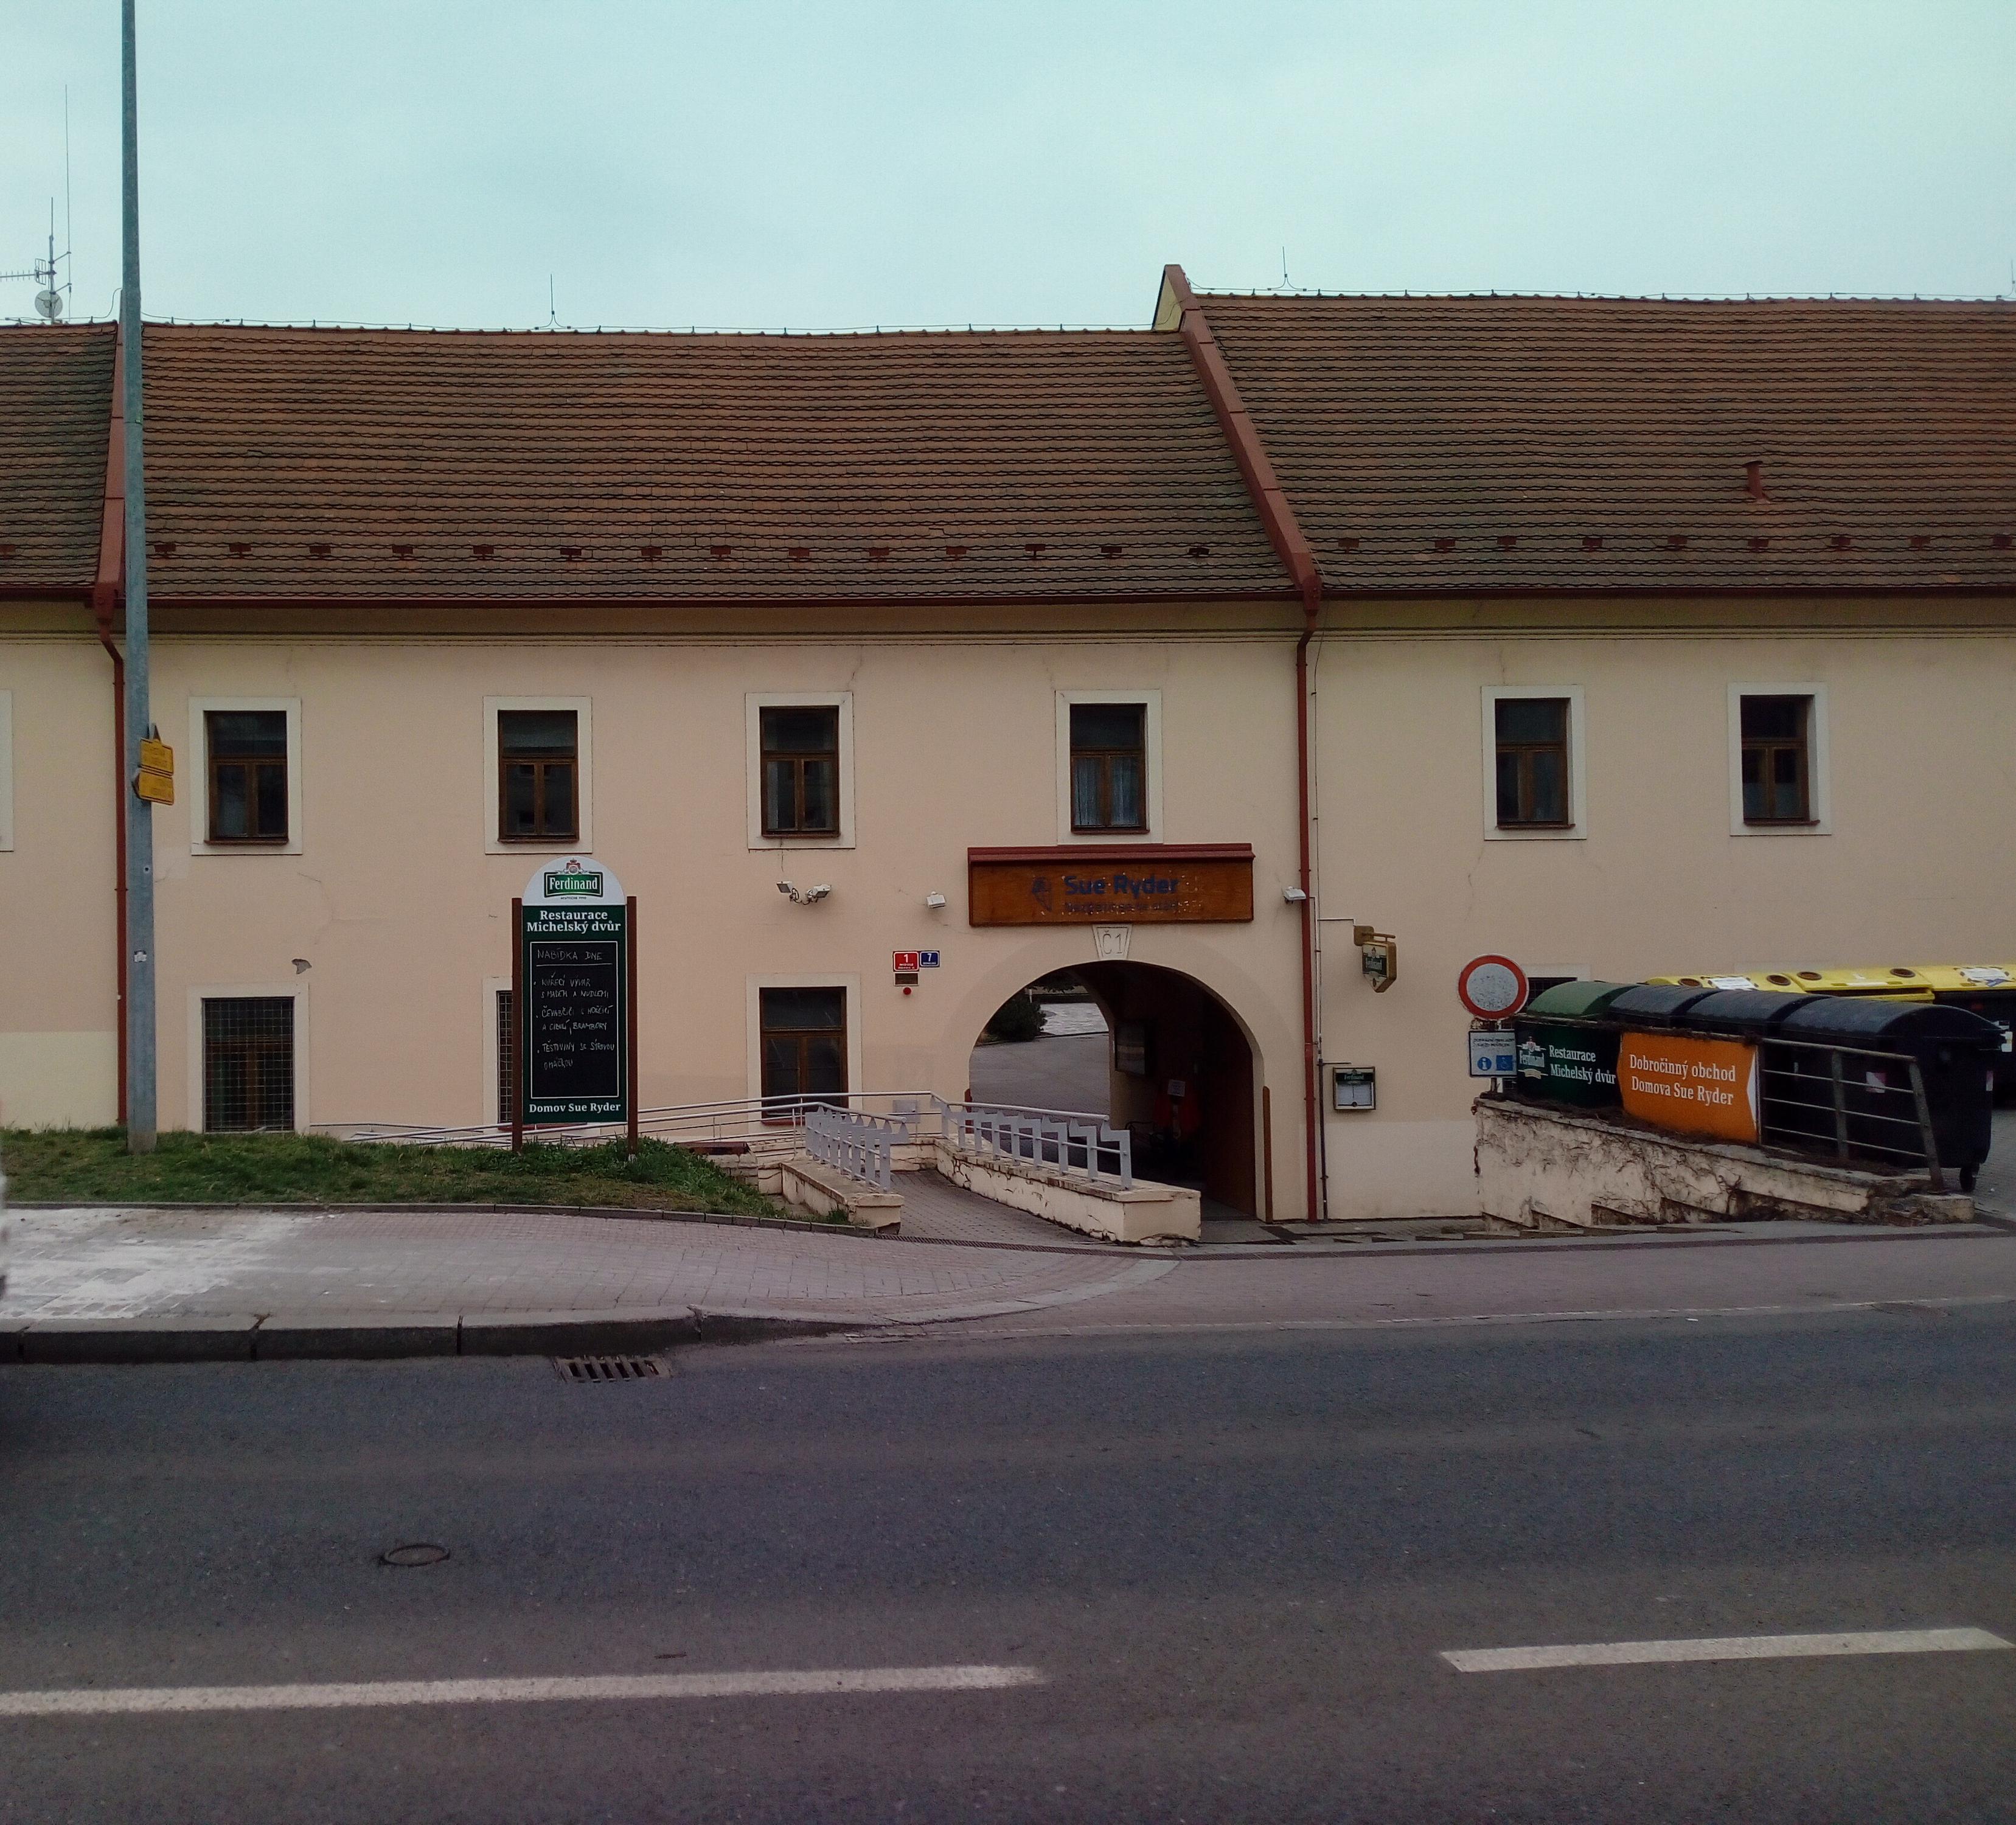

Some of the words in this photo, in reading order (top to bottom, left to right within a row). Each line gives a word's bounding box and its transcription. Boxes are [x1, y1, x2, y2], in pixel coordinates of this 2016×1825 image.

[549, 877, 598, 890] Ferdinand
[1065, 875, 1106, 895] Sue
[1113, 874, 1180, 899] Ryder
[540, 910, 608, 920] Restaurace
[526, 921, 589, 934] Michelský
[591, 920, 621, 931] dvůr
[537, 948, 579, 961] NABÍDKA
[584, 951, 603, 961] DNE
[903, 953, 909, 963] 1
[926, 953, 933, 962] 7
[580, 989, 609, 998] NUDLEMI
[1548, 1045, 1596, 1062] Restaurace
[1549, 1063, 1593, 1085] Michelský
[1594, 1068, 1617, 1085] dvůr
[1629, 1054, 1689, 1080] Dobročinný
[1691, 1061, 1736, 1082] obchod
[1631, 1076, 1671, 1096] Domova
[1674, 1082, 1694, 1100] Sue
[1697, 1085, 1734, 1106] Ryder
[529, 1104, 566, 1113] Domov
[568, 1103, 588, 1113] Sue
[589, 1102, 621, 1115] Ryder
